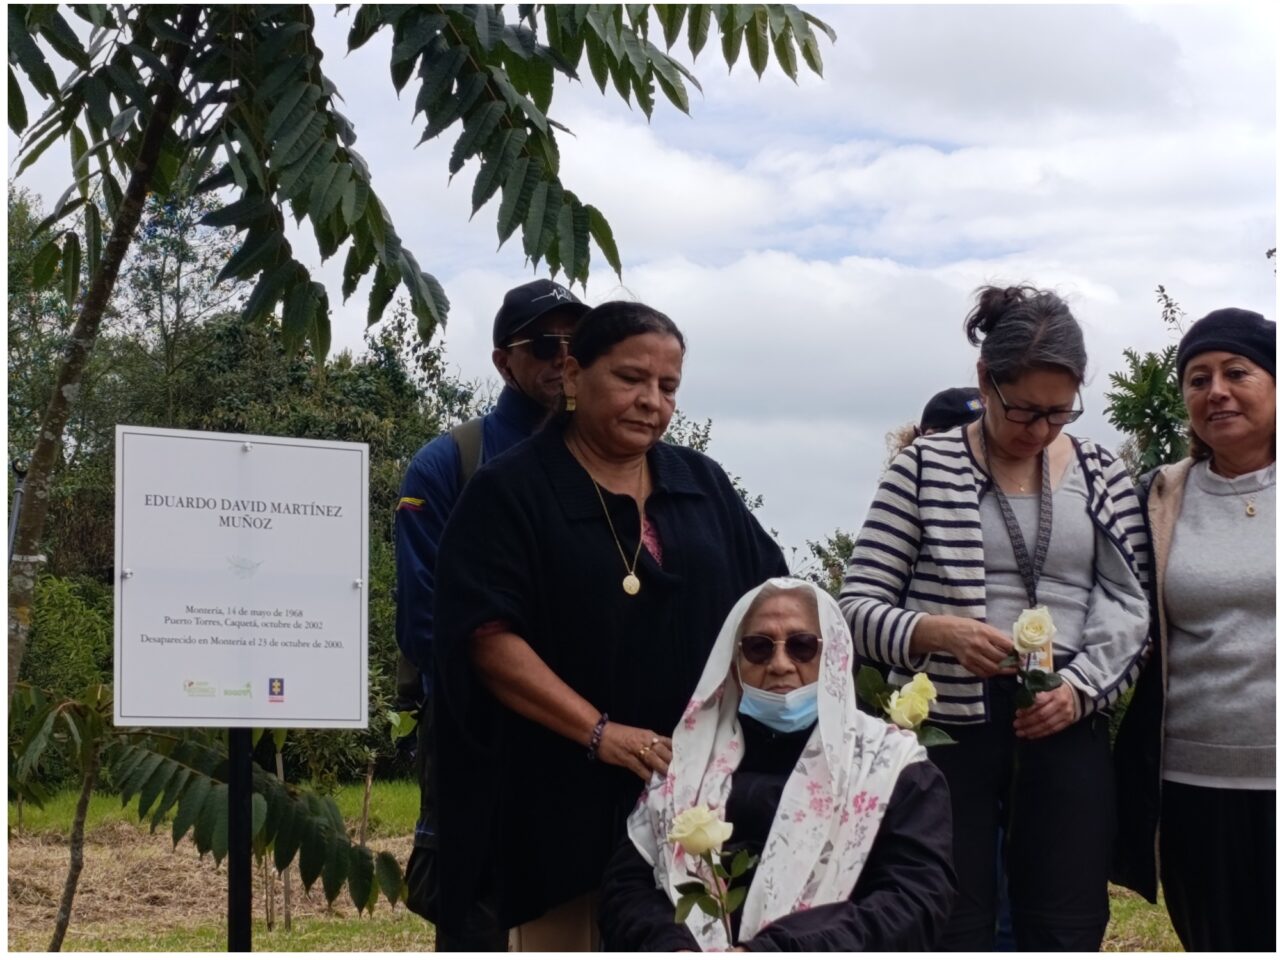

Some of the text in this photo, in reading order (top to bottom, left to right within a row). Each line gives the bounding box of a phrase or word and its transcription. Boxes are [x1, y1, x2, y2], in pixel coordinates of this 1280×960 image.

[145, 494, 343, 518] EDUARDO DAVID MARTÍNEZ
[219, 514, 273, 530] MUÑOZ
[185, 605, 303, 618] Montería, 14 de mayo de 1968
[164, 616, 323, 630] Puerto Torres, Caquetá, octubre de 2002
[140, 634, 196, 645] Desaparecido
[248, 638, 255, 646] el
[258, 638, 268, 646] 23
[269, 638, 279, 647] de
[280, 639, 311, 648] octubre
[312, 639, 322, 648] de
